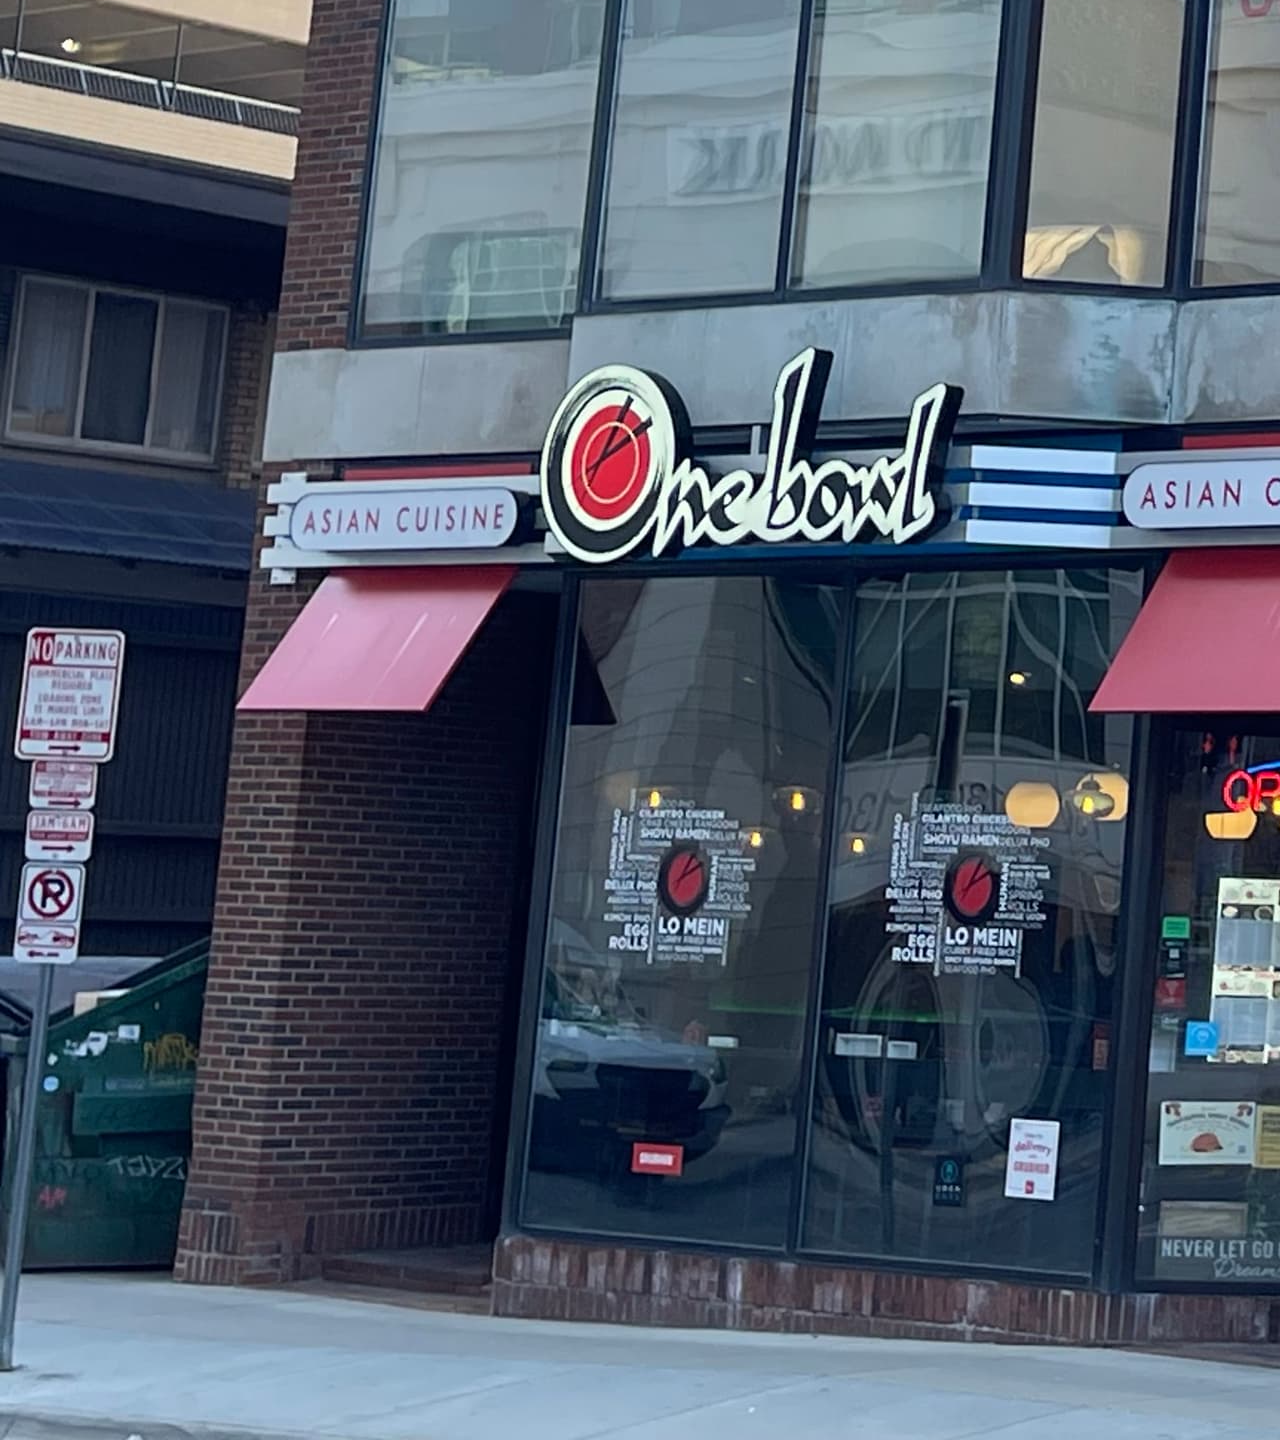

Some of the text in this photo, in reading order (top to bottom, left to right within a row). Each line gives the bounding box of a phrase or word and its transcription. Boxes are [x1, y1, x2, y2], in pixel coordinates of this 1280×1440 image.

[1140, 478, 1243, 510] ASIAN
[303, 503, 504, 535] ASIAN CUISINE
[31, 636, 118, 661] NO PARKING
[886, 888, 942, 899] DELUX PHO
[624, 923, 649, 936] EGG
[658, 916, 724, 936] LO MEIN
[608, 937, 648, 950] ROLLS
[908, 934, 935, 948] EGG
[945, 927, 1017, 946] LO MEIN
[892, 948, 935, 962] ROLLS
[1161, 1238, 1215, 1258] NEVER
[1219, 1239, 1247, 1258] LET
[1252, 1240, 1274, 1259] GO
